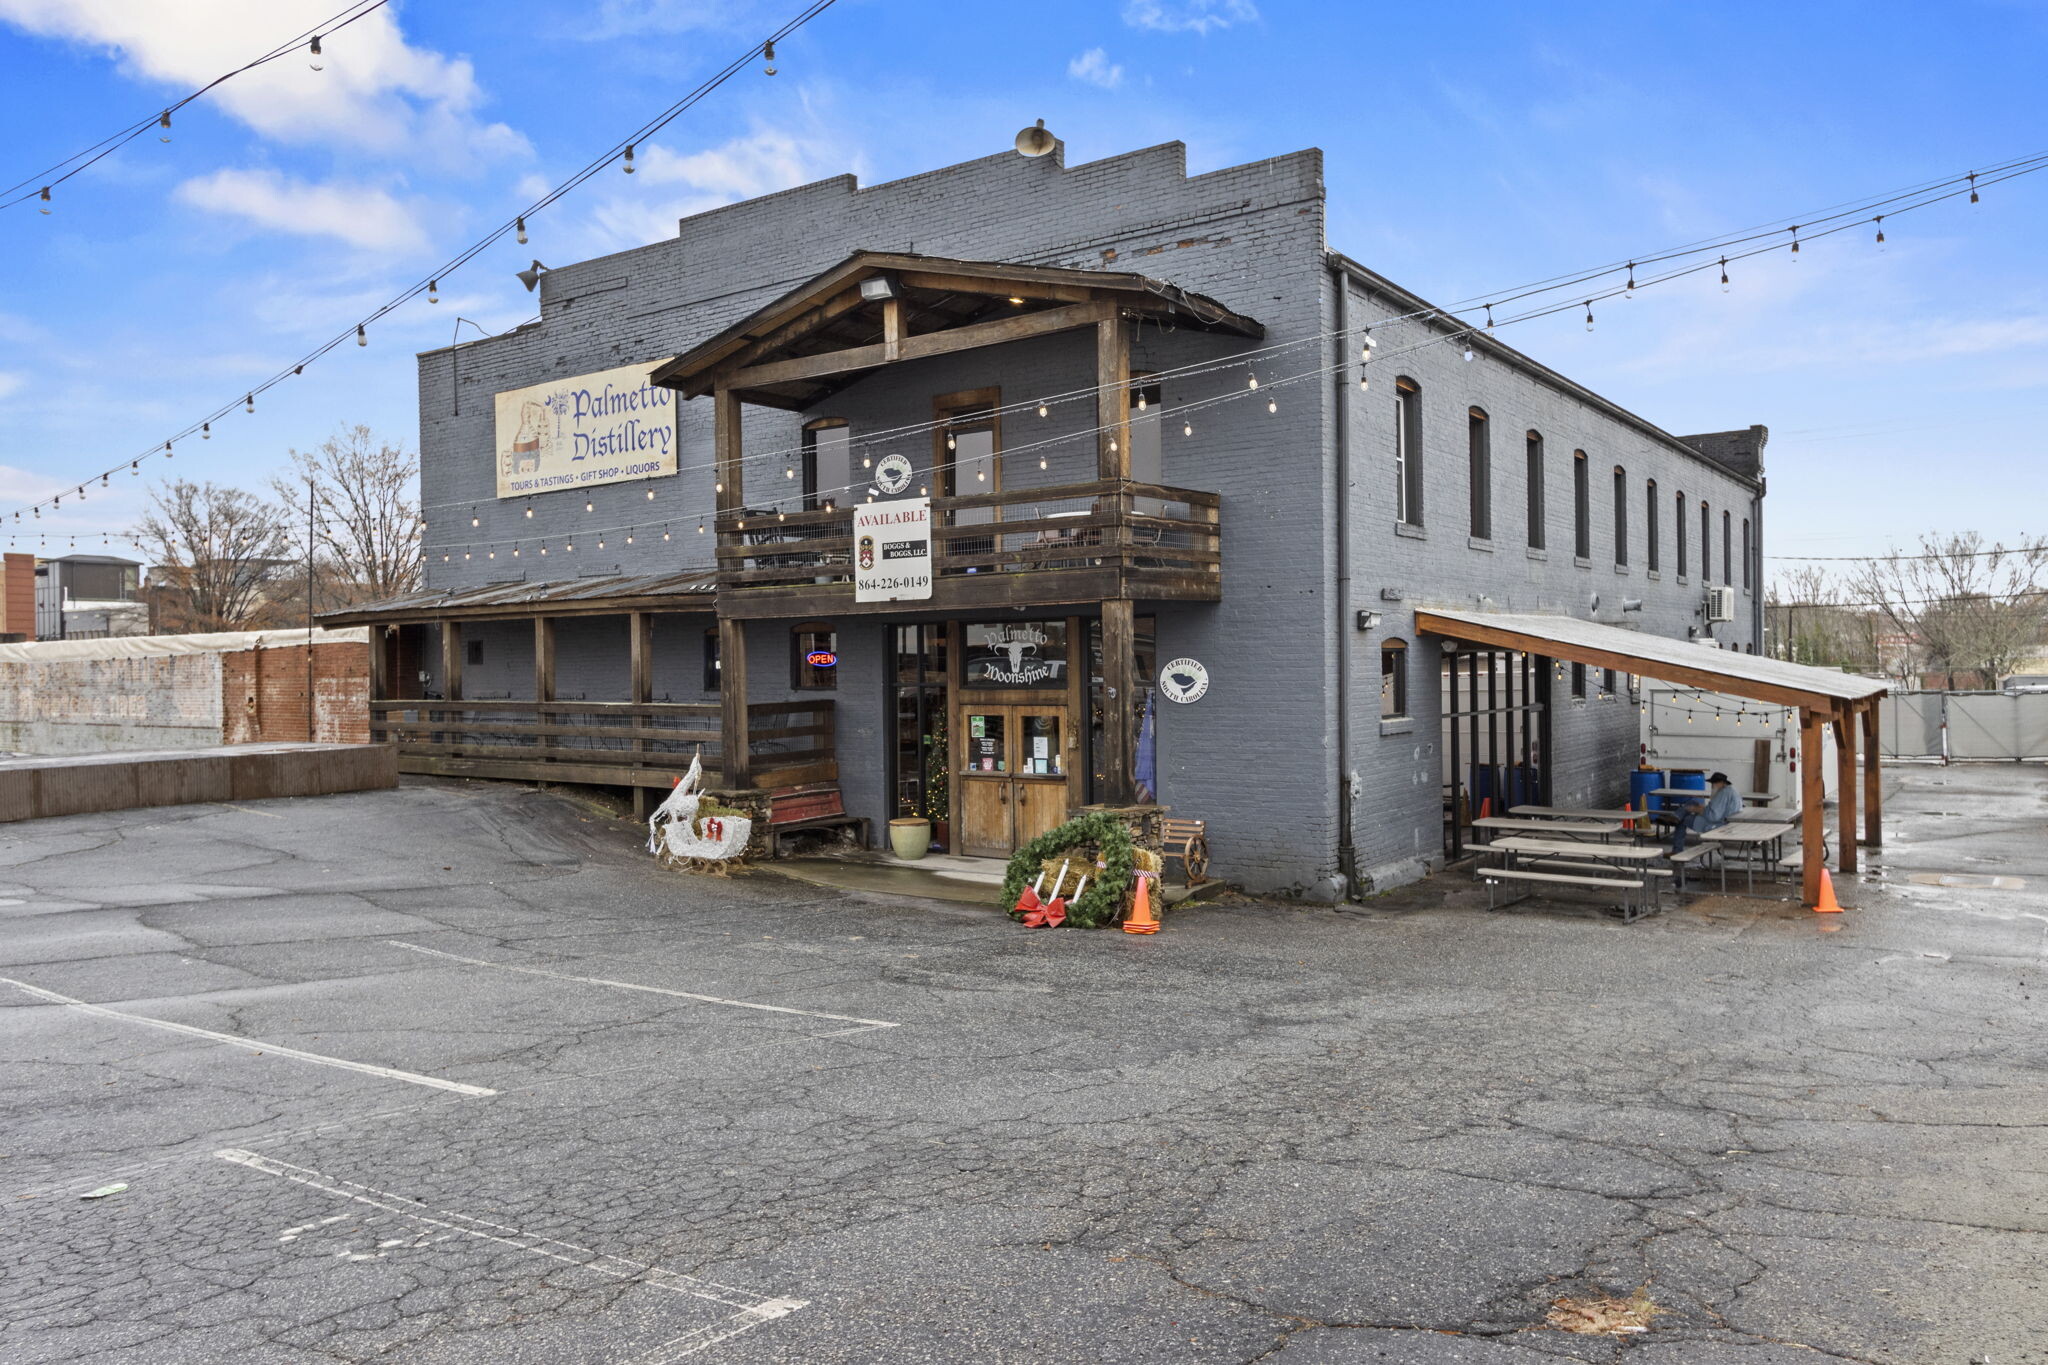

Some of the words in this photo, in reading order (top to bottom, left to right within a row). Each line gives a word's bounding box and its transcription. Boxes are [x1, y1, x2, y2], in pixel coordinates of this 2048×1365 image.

[571, 381, 671, 429] Palmetto
[572, 418, 671, 461] Distillery
[511, 479, 532, 491] TOURS
[534, 478, 539, 488] &
[540, 474, 574, 487] TASTINGS
[580, 470, 597, 482] GIFT
[598, 467, 619, 479] SHOP
[625, 461, 660, 476] LIQUORS
[858, 510, 927, 527] AVAILABLE
[858, 576, 929, 590] 864-226-0149
[984, 624, 1048, 650] Palmetto
[809, 654, 834, 664] OPEN
[1167, 660, 1203, 672] CERTIFIED
[984, 663, 1049, 685] Moonshine
[1162, 681, 1179, 701] SOUTH
[1180, 682, 1207, 702] CAROLINA
